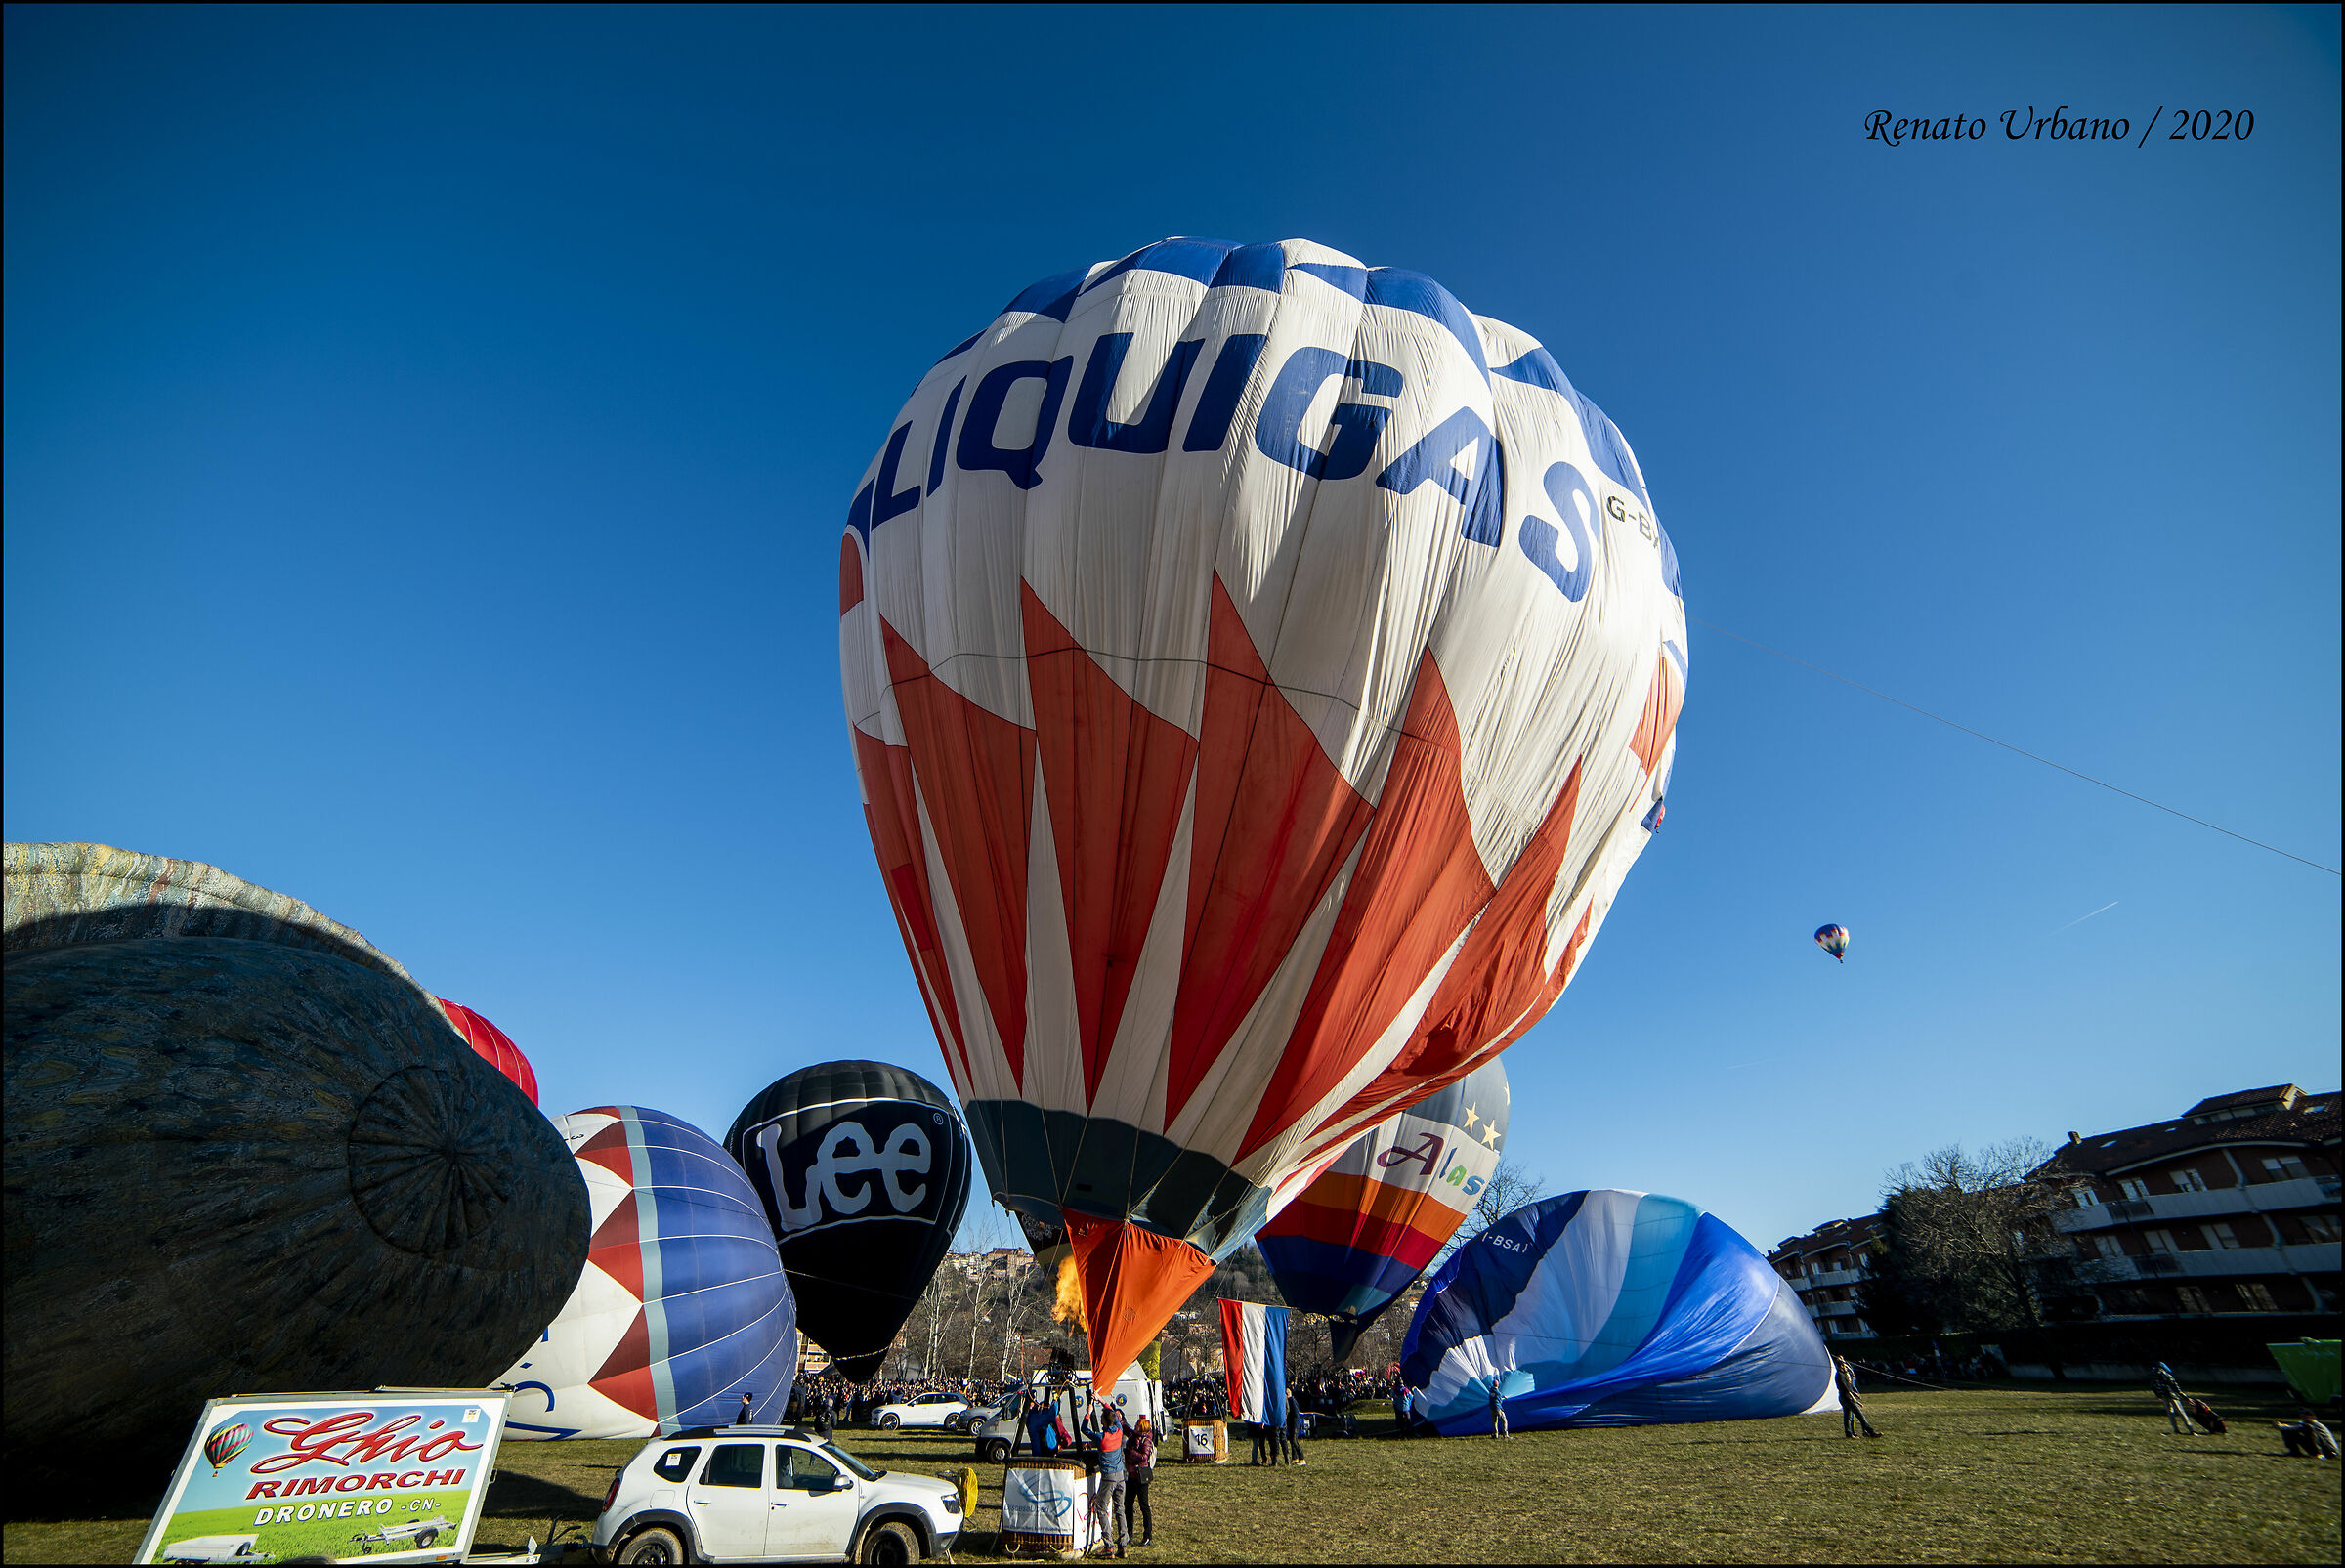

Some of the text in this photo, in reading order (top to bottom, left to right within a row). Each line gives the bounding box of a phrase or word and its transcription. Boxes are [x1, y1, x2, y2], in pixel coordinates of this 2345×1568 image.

[870, 332, 1601, 603] LIQUIGAS
[756, 1121, 932, 1233] Lee
[1376, 1131, 1486, 1196] Alas
[250, 1411, 484, 1474] Ghio
[1194, 1432, 1209, 1447] 16
[245, 1468, 467, 1501] RIMORCHI
[253, 1498, 394, 1527] DRONERO
